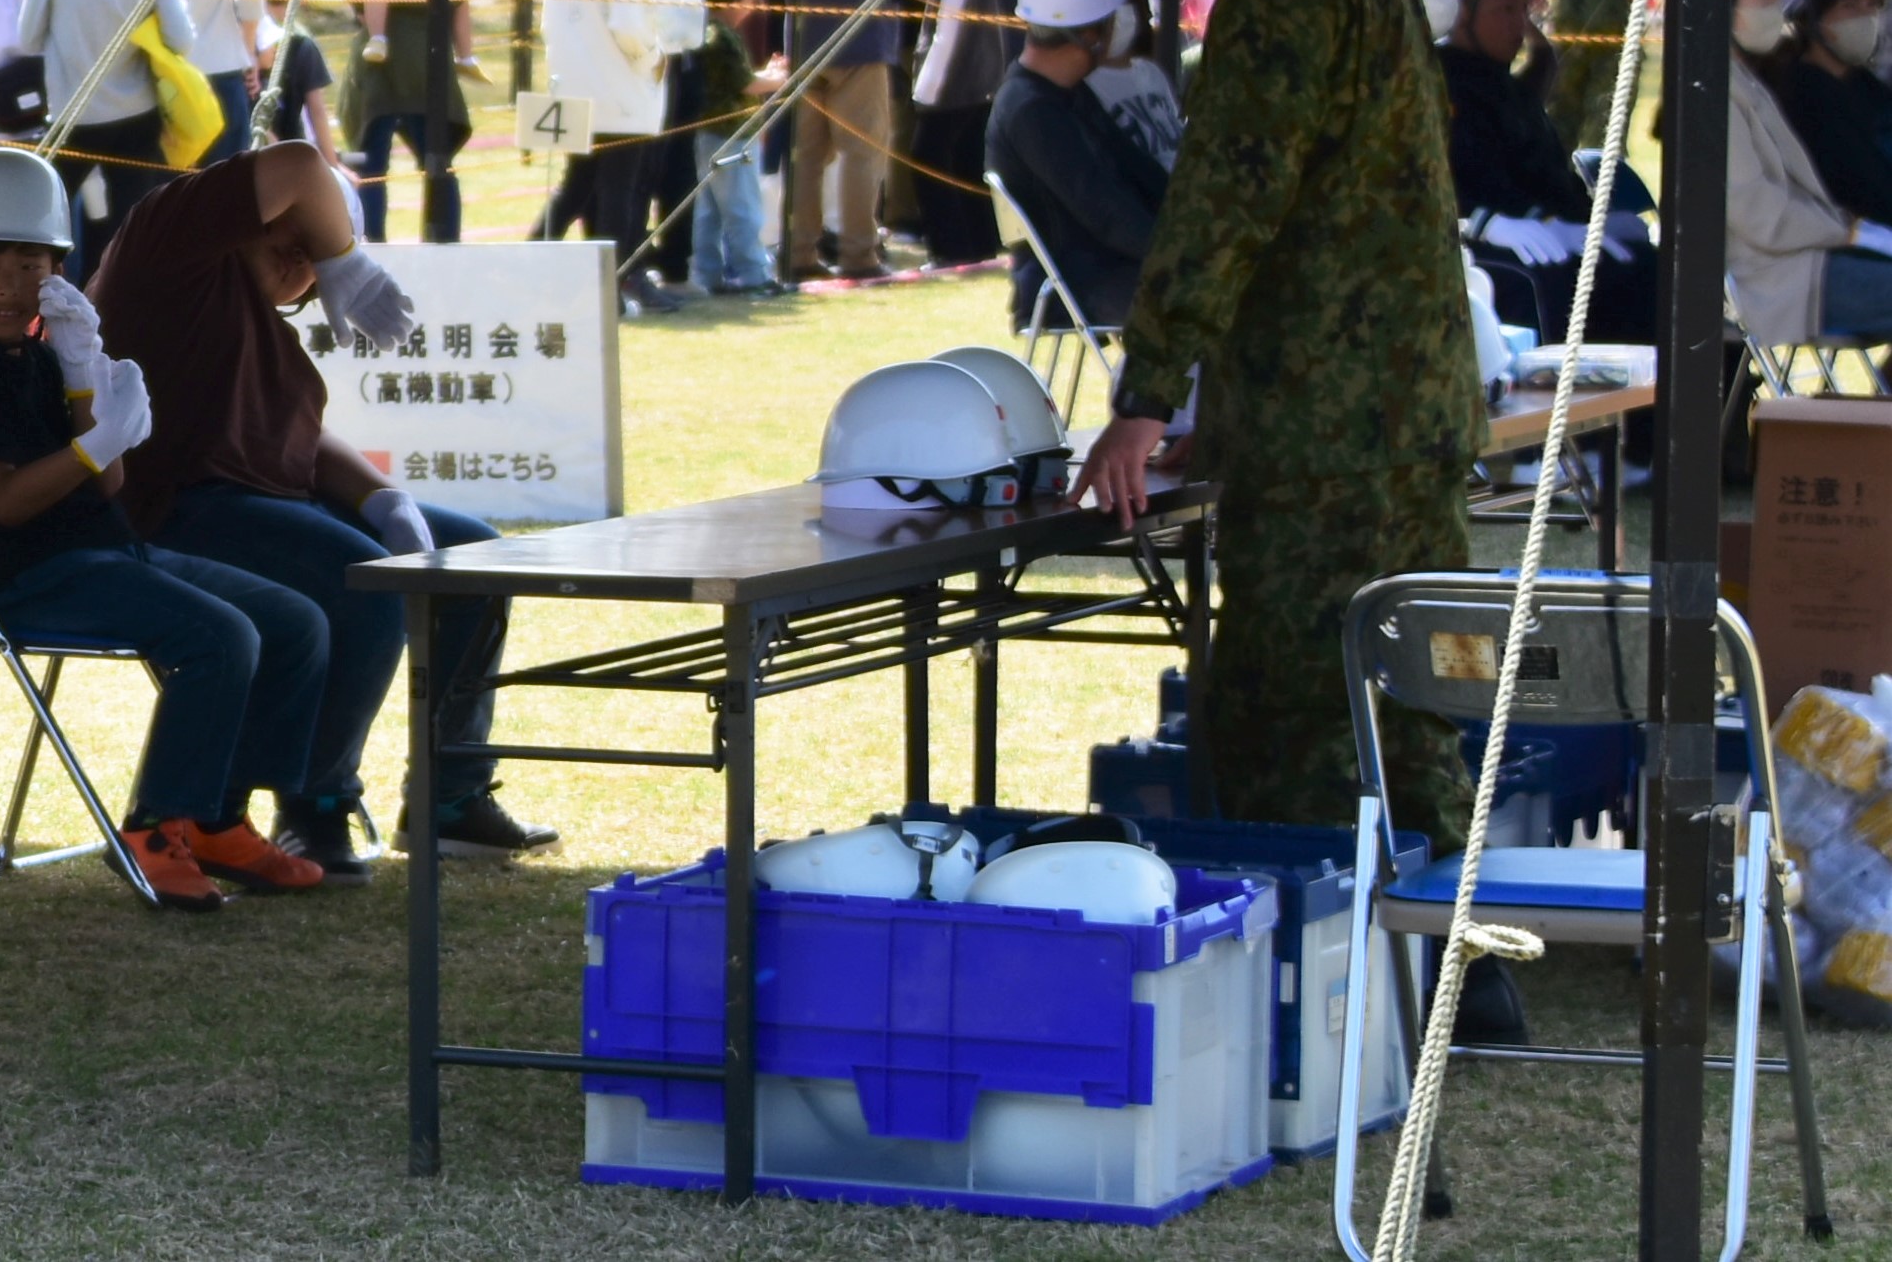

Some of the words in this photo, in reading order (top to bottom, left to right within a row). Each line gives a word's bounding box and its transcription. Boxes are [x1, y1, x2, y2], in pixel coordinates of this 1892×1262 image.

[534, 101, 567, 143] 4
[404, 450, 557, 482] 会場はこちら
